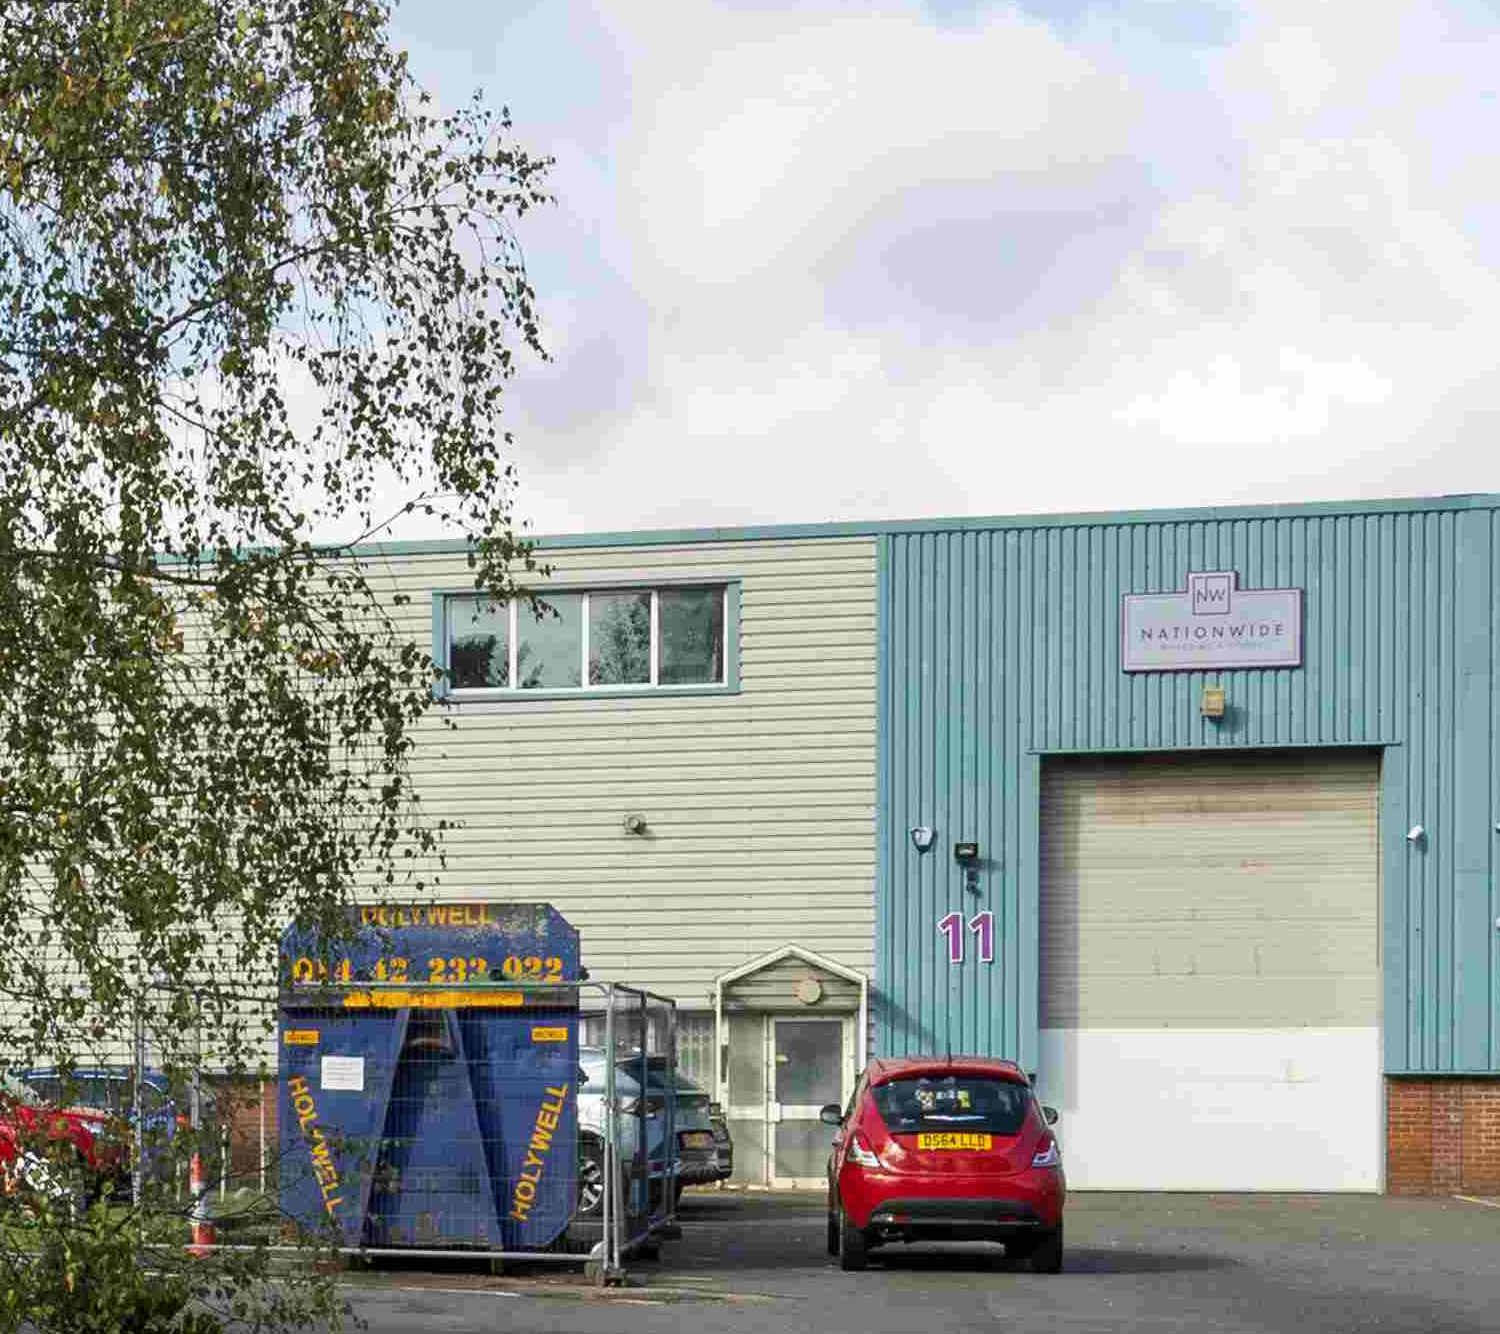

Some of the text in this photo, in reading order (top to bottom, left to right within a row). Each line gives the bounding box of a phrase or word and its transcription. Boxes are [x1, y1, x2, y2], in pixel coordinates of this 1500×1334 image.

[1141, 624, 1284, 640] NATIONWIDE
[937, 911, 993, 962] 11
[510, 1083, 569, 1222] HOLYWELL
